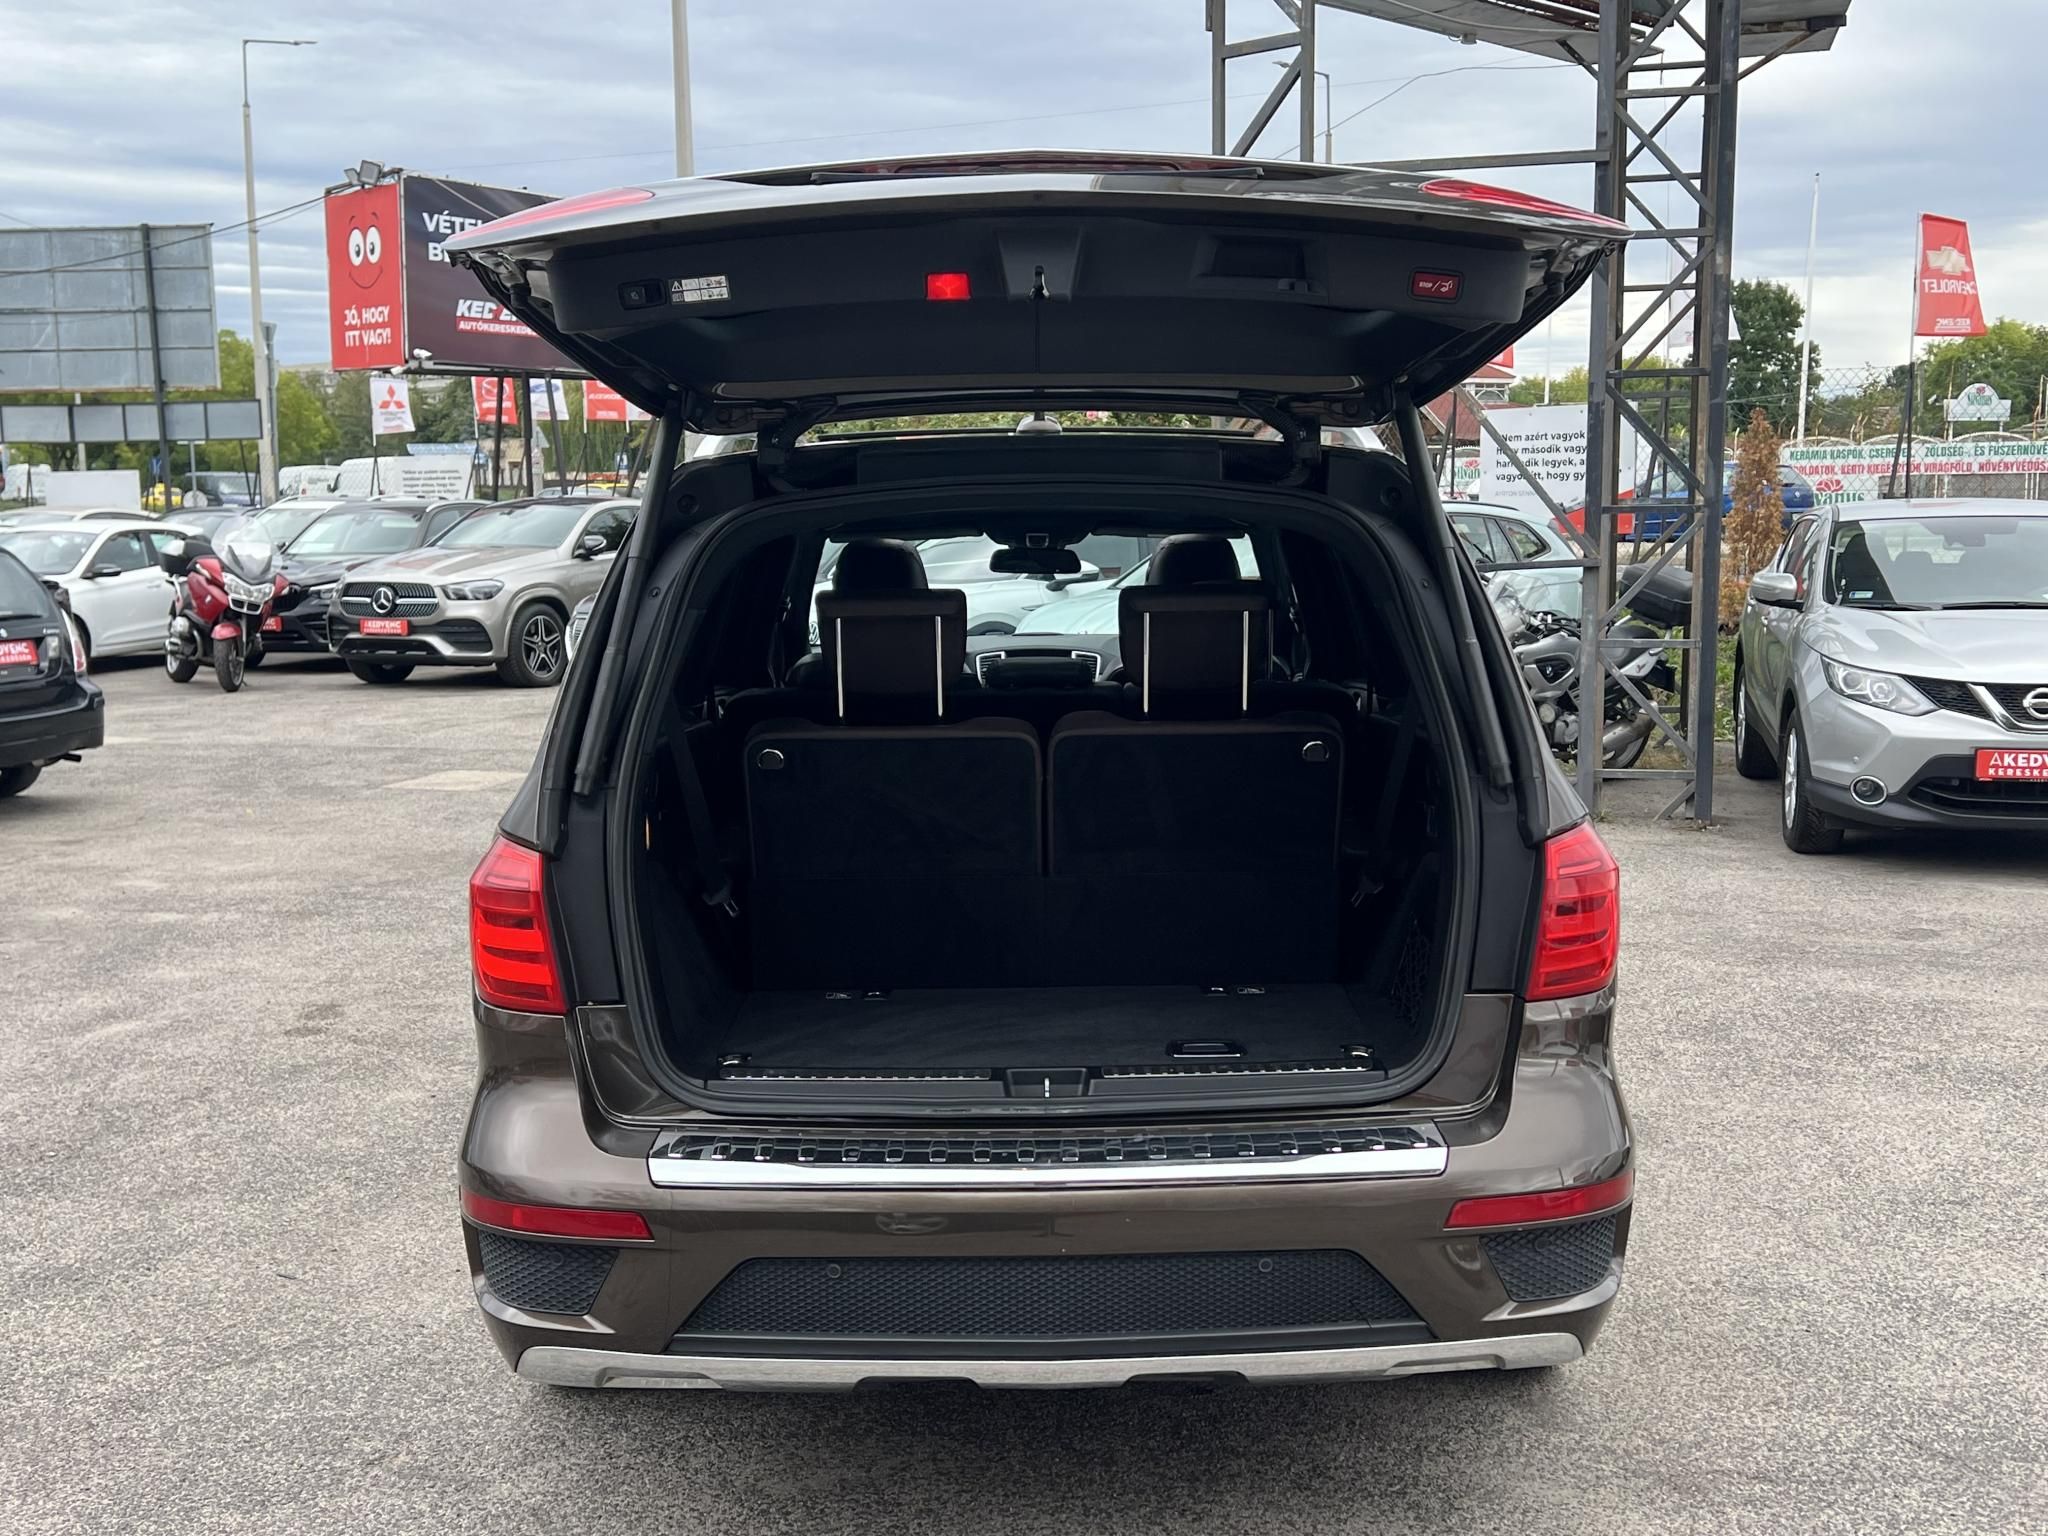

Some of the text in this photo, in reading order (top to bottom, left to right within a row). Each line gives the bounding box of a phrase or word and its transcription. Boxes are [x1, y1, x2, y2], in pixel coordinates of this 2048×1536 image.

[344, 304, 390, 328] JÓ, HOGY
[345, 327, 391, 348] ITT VAGY!
[1524, 431, 1548, 441] azért
[1550, 430, 1586, 442] vagyok
[1521, 444, 1561, 454] második
[1541, 457, 1577, 469] legyek,
[1978, 458, 2048, 473] NÖVÉNYVÉDŐS
[1496, 473, 1526, 483] vagyo
[1546, 470, 1570, 482] hogy
